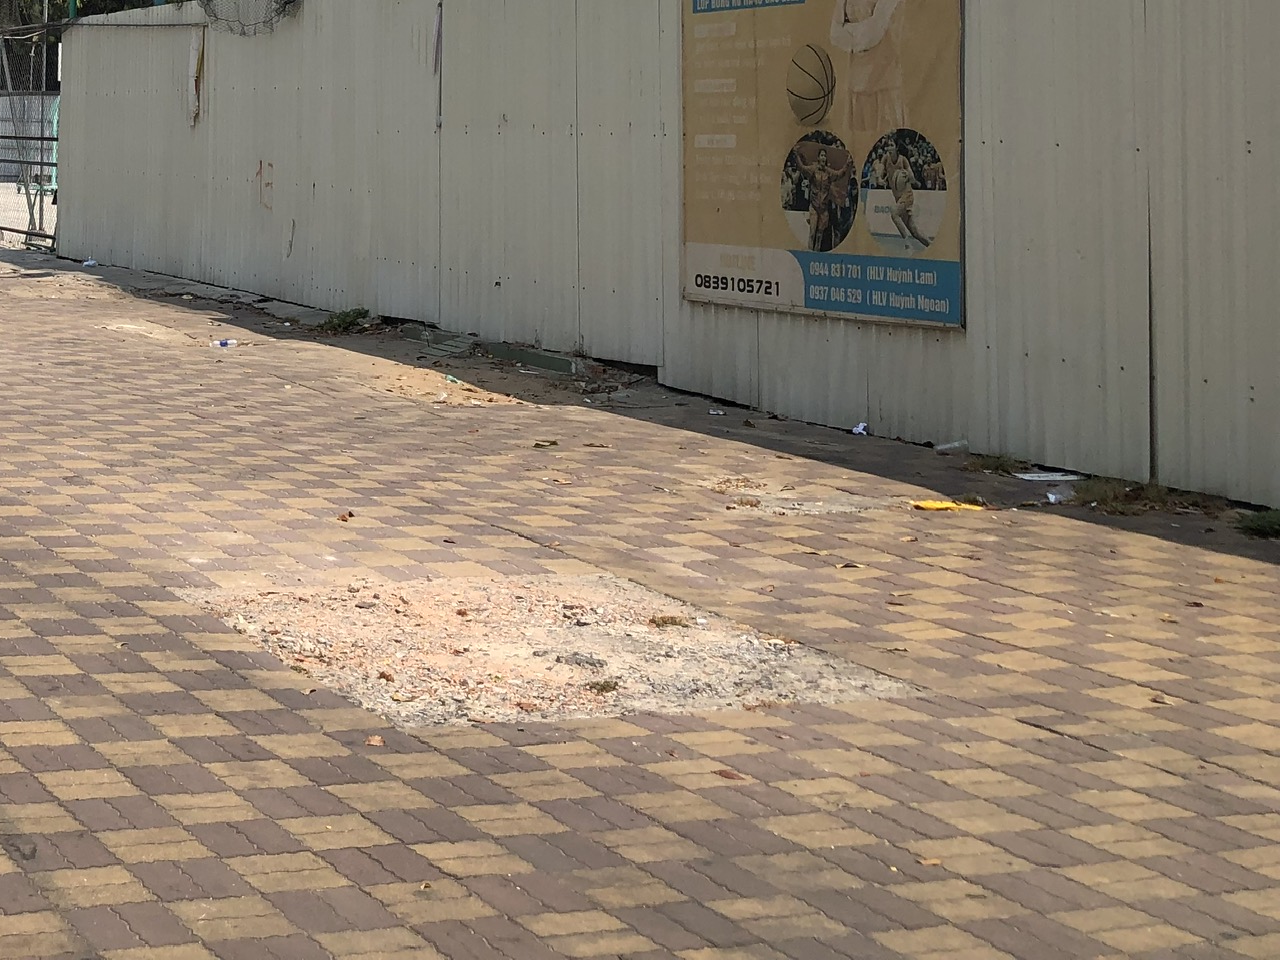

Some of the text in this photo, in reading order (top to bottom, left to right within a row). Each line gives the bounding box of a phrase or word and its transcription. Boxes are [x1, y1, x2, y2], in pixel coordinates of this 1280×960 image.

[809, 261, 829, 277] 0944
[847, 264, 861, 280] 701
[694, 273, 779, 297] 0839105721
[809, 285, 828, 301] 0937
[830, 286, 845, 303] 046
[847, 288, 862, 304] 529
[872, 290, 887, 307] HLV
